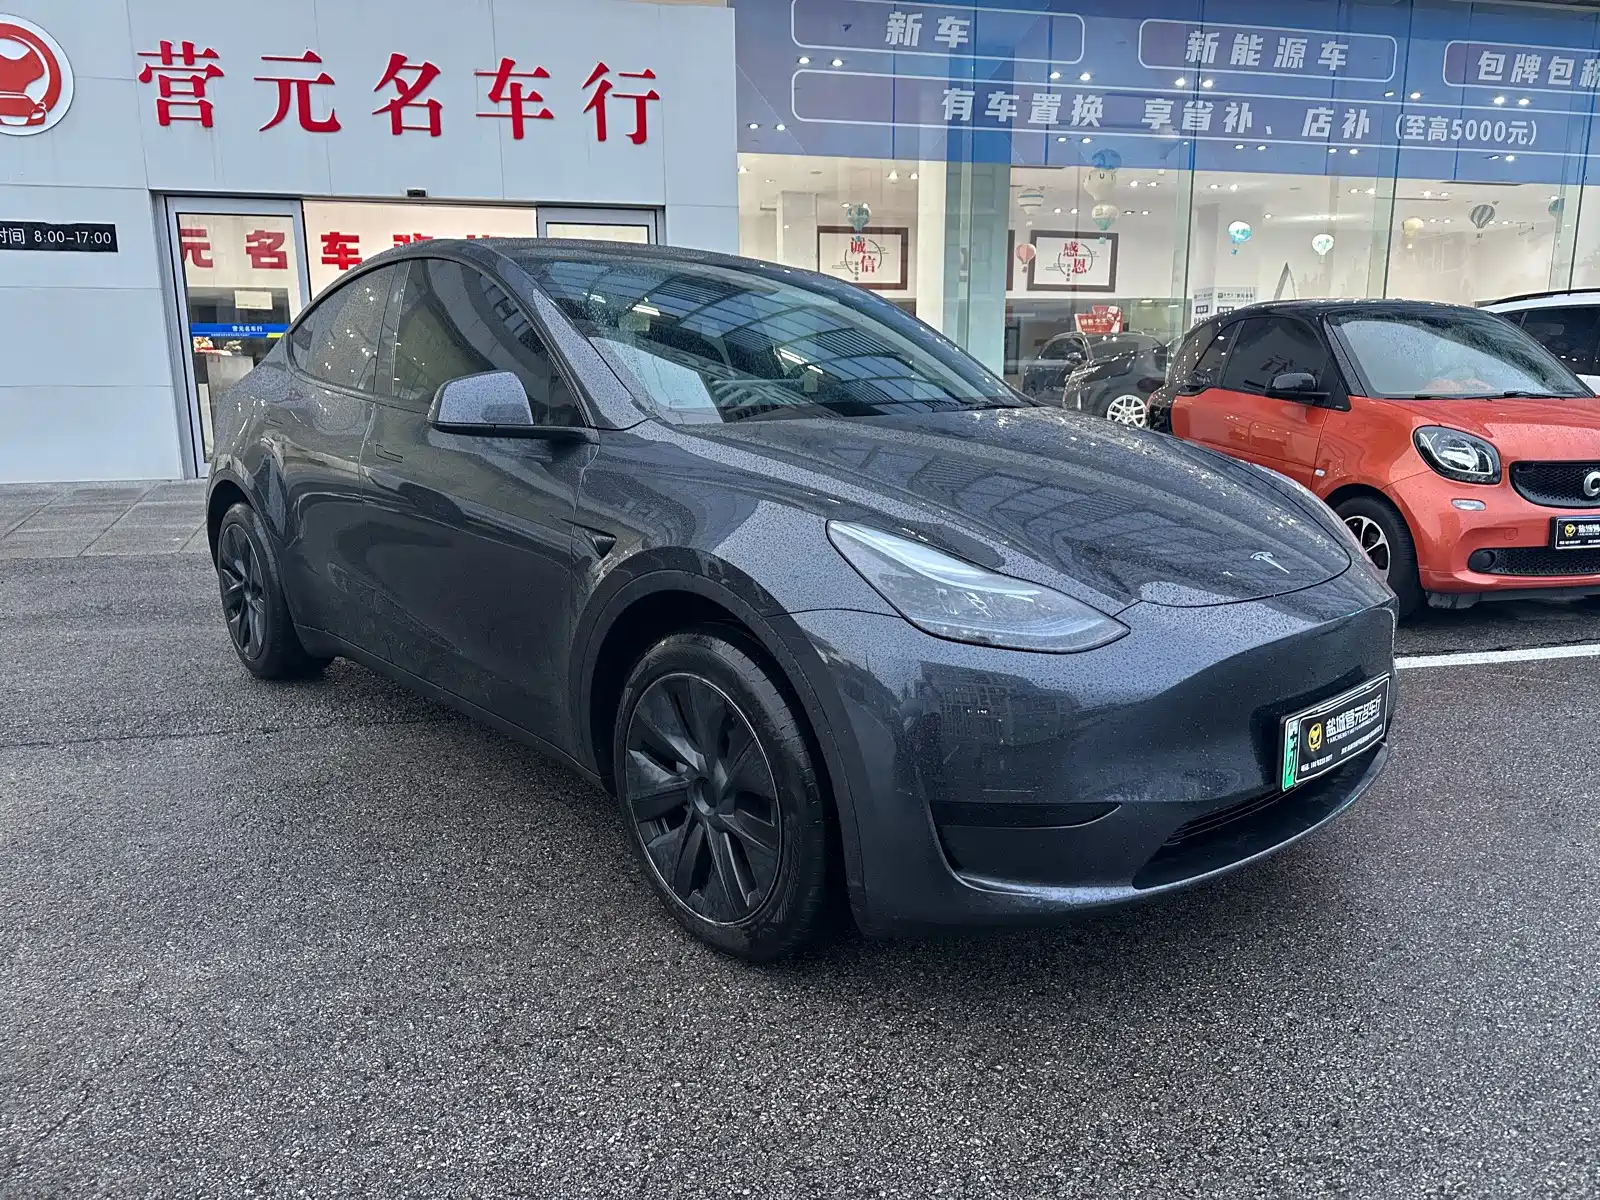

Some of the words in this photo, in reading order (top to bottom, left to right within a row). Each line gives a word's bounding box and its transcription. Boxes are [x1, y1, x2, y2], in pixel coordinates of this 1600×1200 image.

[885, 12, 970, 48] 新车
[1185, 31, 1350, 71] 新能源车
[138, 40, 660, 145] 营元名车行
[941, 88, 1103, 127] 有车置换
